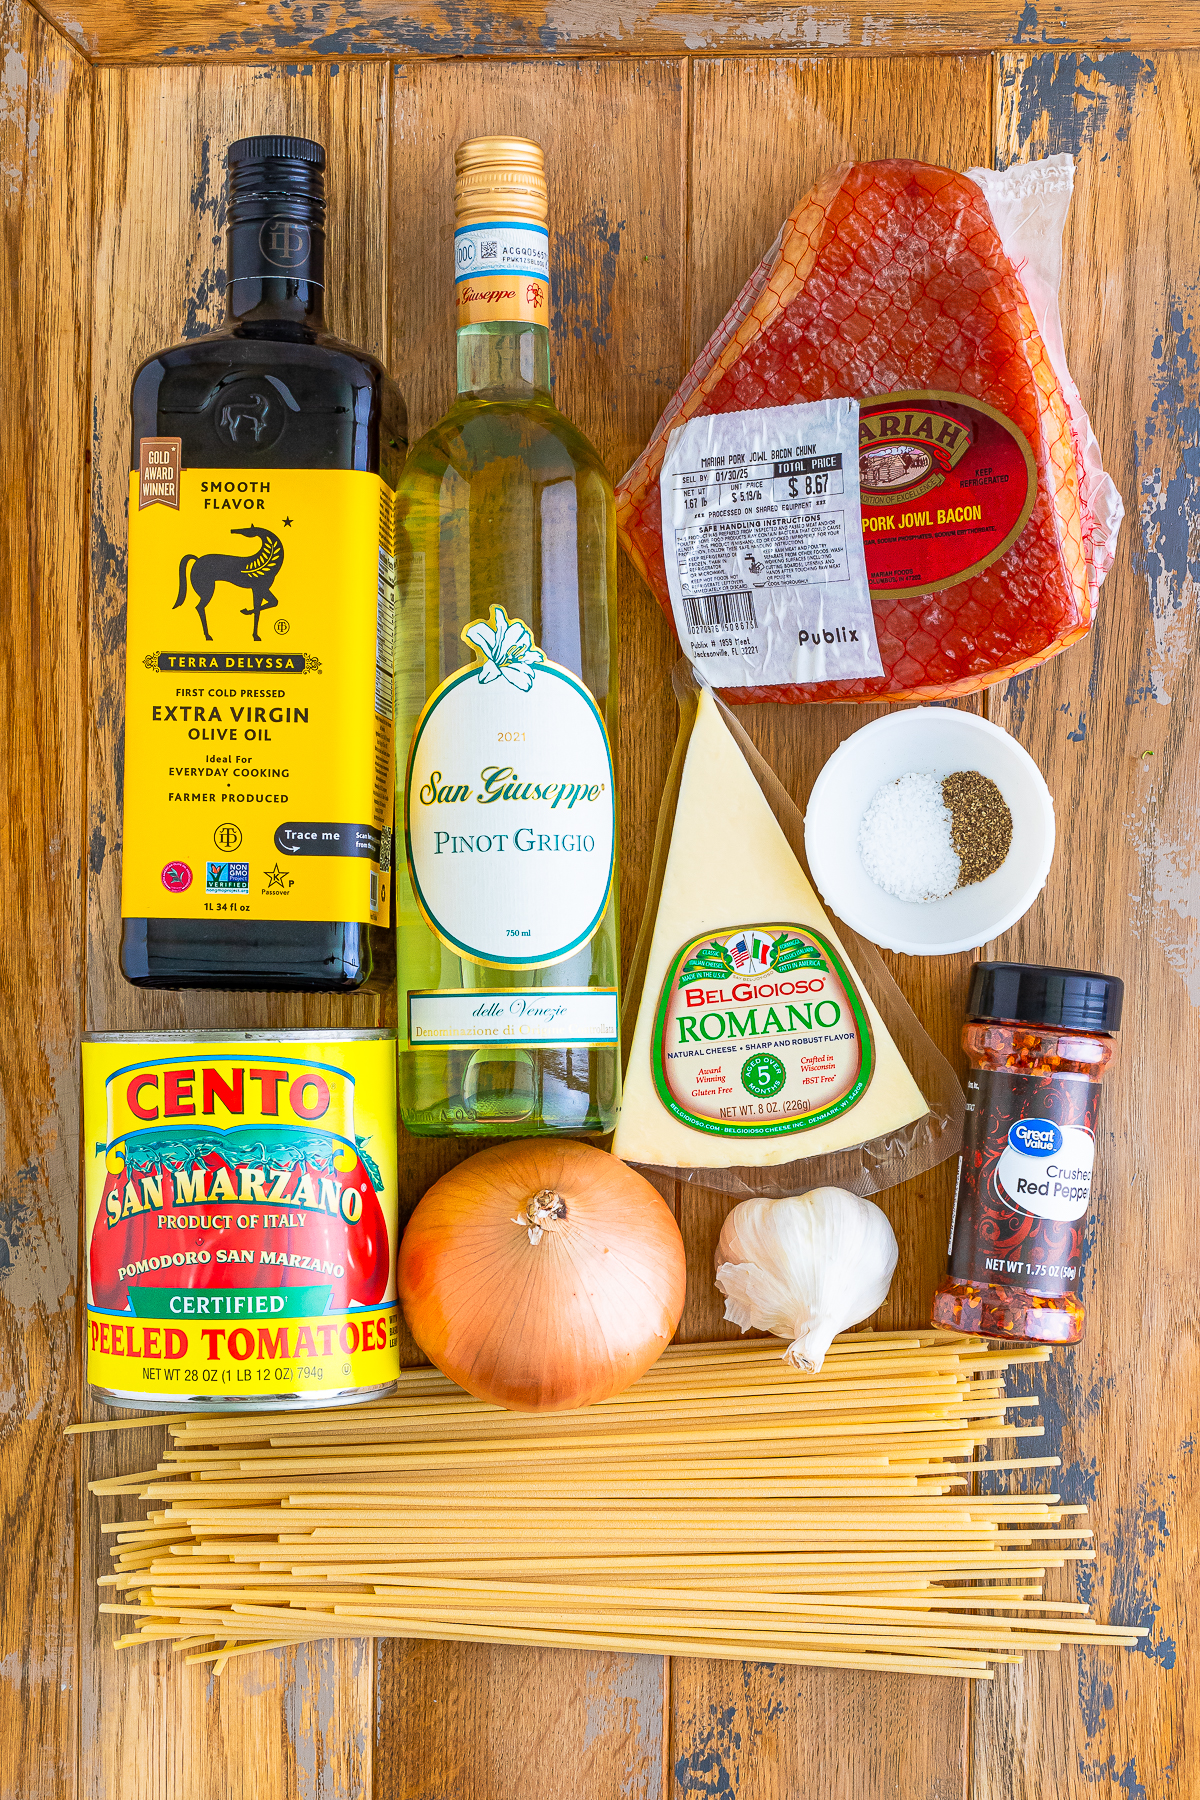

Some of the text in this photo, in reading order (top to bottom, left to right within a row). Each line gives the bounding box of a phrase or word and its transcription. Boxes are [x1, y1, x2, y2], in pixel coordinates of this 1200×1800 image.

[461, 286, 516, 305] Giuseppe
[859, 414, 962, 448] ARIAH
[148, 450, 170, 465] GOLD
[701, 444, 817, 468] MARIAH PORK JOWL BACON CHUNK
[777, 456, 837, 474] TOTAL PRICE
[144, 466, 174, 481] AWARD
[682, 475, 697, 484] SELL
[715, 468, 748, 482] 01/30/25
[975, 468, 993, 477] KEEP
[200, 481, 271, 493] SMOOTH
[746, 481, 763, 489] PRICE
[788, 473, 829, 498] $ 8.67
[959, 475, 1009, 488] REFRIGERATED
[142, 482, 175, 496] WINNER
[683, 488, 706, 497] NET WT
[896, 477, 938, 502] EXCELLENCE
[204, 498, 266, 510] FLAVOR
[684, 496, 708, 509] 1.67 lb
[731, 492, 738, 503] $
[708, 501, 812, 519] PROCESSED ON SHARED EQUIPMENT
[698, 514, 821, 534] SAFE HANDLING INSTRUCTIONS
[861, 505, 982, 533] PORK JOWL BACON
[870, 568, 914, 578] MARIAH FOODS
[798, 627, 859, 647] Publix
[690, 640, 709, 650] Publix
[693, 646, 759, 659] Jacksonville, FL 32221
[168, 656, 295, 669] TERRA DELYSSA
[176, 688, 286, 698] FIRST COLD PRESSED
[152, 706, 309, 724] EXTRA VIRGIN
[187, 728, 272, 742] OLIVE OIL
[497, 731, 527, 743] 2021
[205, 754, 253, 764] Ideal For
[168, 767, 290, 778] EVERYDAY COOKING
[419, 766, 601, 810] San Giuseppe
[168, 792, 289, 803] FARMER PRODUCED
[284, 829, 340, 841] Trace me
[355, 832, 368, 840] Scan
[433, 828, 596, 855] PINOT GRIGIO
[355, 841, 368, 849] from
[288, 880, 295, 888] P
[203, 902, 213, 912] 1L
[216, 903, 228, 912] 34
[230, 902, 238, 912] fl
[505, 930, 531, 938] 750 ml
[702, 949, 720, 957] CLASSIC
[705, 960, 724, 969] CHEESES
[778, 960, 821, 973] FATTI IN AMERICA
[681, 972, 696, 983] MADE
[472, 997, 568, 1023] delle Venezie
[675, 1000, 841, 1044] ROMANO
[415, 1025, 515, 1038] Denominazione di
[667, 1032, 856, 1060] NATURAL CHEESE SHARP AND ROBUST FLAVOR
[800, 1055, 826, 1065] Crafted
[697, 1066, 722, 1076] Award
[745, 1057, 782, 1078] AGED OVER
[800, 1063, 836, 1073] Wisconsin
[695, 1075, 726, 1084] Winning
[757, 1065, 771, 1086] 5
[802, 1076, 820, 1085] rBST
[126, 1067, 331, 1122] CENTO
[691, 1086, 733, 1097] Gluten Free
[748, 1080, 781, 1095] MONTHS
[719, 1099, 811, 1119] NET WT. 8 OZ. (226g)
[670, 1102, 720, 1132] BELGIOIOSO.COM
[764, 1124, 792, 1133] CHEESE
[792, 1121, 807, 1129] INC.
[807, 1106, 842, 1125] DENMARK,
[839, 1100, 849, 1110] WI
[1015, 1126, 1055, 1143] Great
[1024, 1138, 1053, 1151] Value
[1016, 1177, 1050, 1197] Red
[106, 1166, 364, 1228] SAN MARZANO
[157, 1213, 308, 1230] PRODUCT OF ITALY
[117, 1250, 345, 1282] POMODORO SAN MARZANO
[985, 1257, 1077, 1280] NET WT 1.75 OZ (50g)
[169, 1295, 284, 1314] CERTIFIED
[91, 1317, 388, 1361] PEELED TOMATOES
[142, 1366, 324, 1384] NET WT 28 OZ (1 LB 12 OZ) 794g
